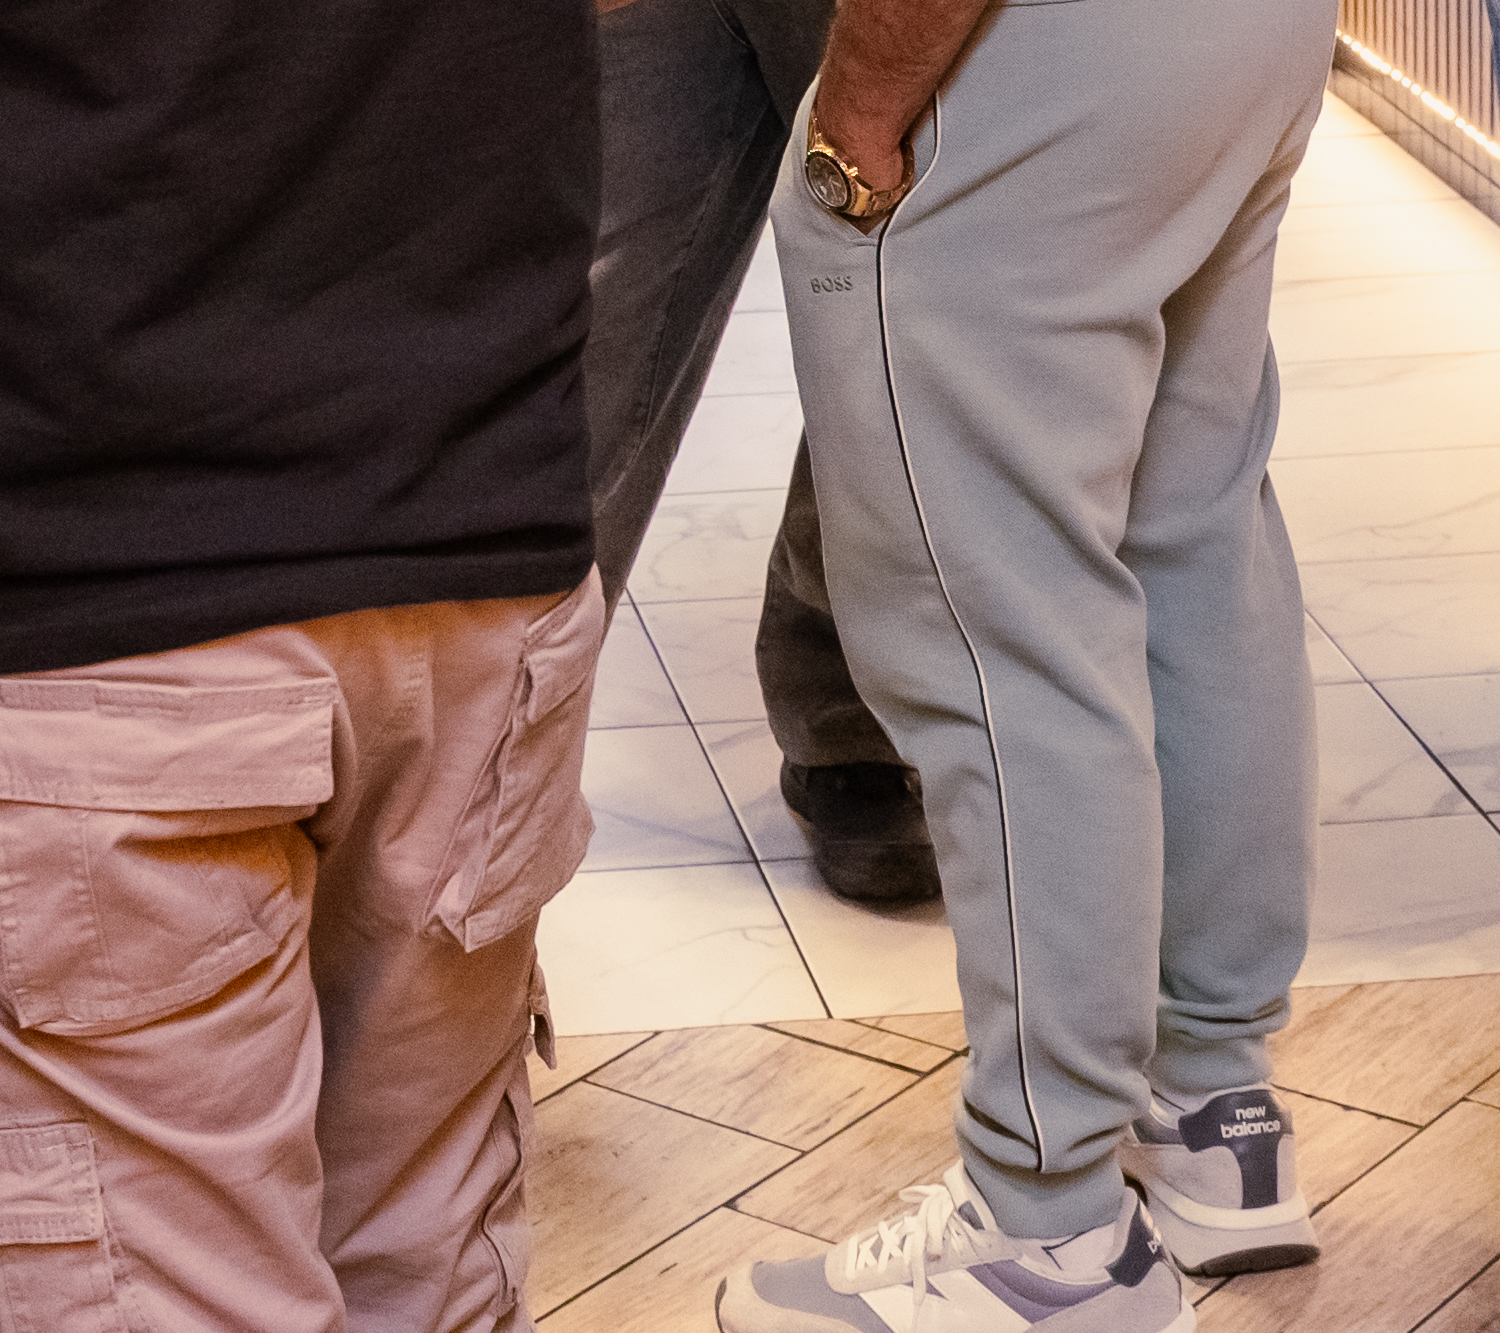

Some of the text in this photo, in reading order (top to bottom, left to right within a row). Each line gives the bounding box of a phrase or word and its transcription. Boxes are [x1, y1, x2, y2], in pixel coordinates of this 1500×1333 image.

[810, 276, 853, 294] BOSS
[1235, 1106, 1266, 1121] new
[1220, 1119, 1281, 1139] balance
